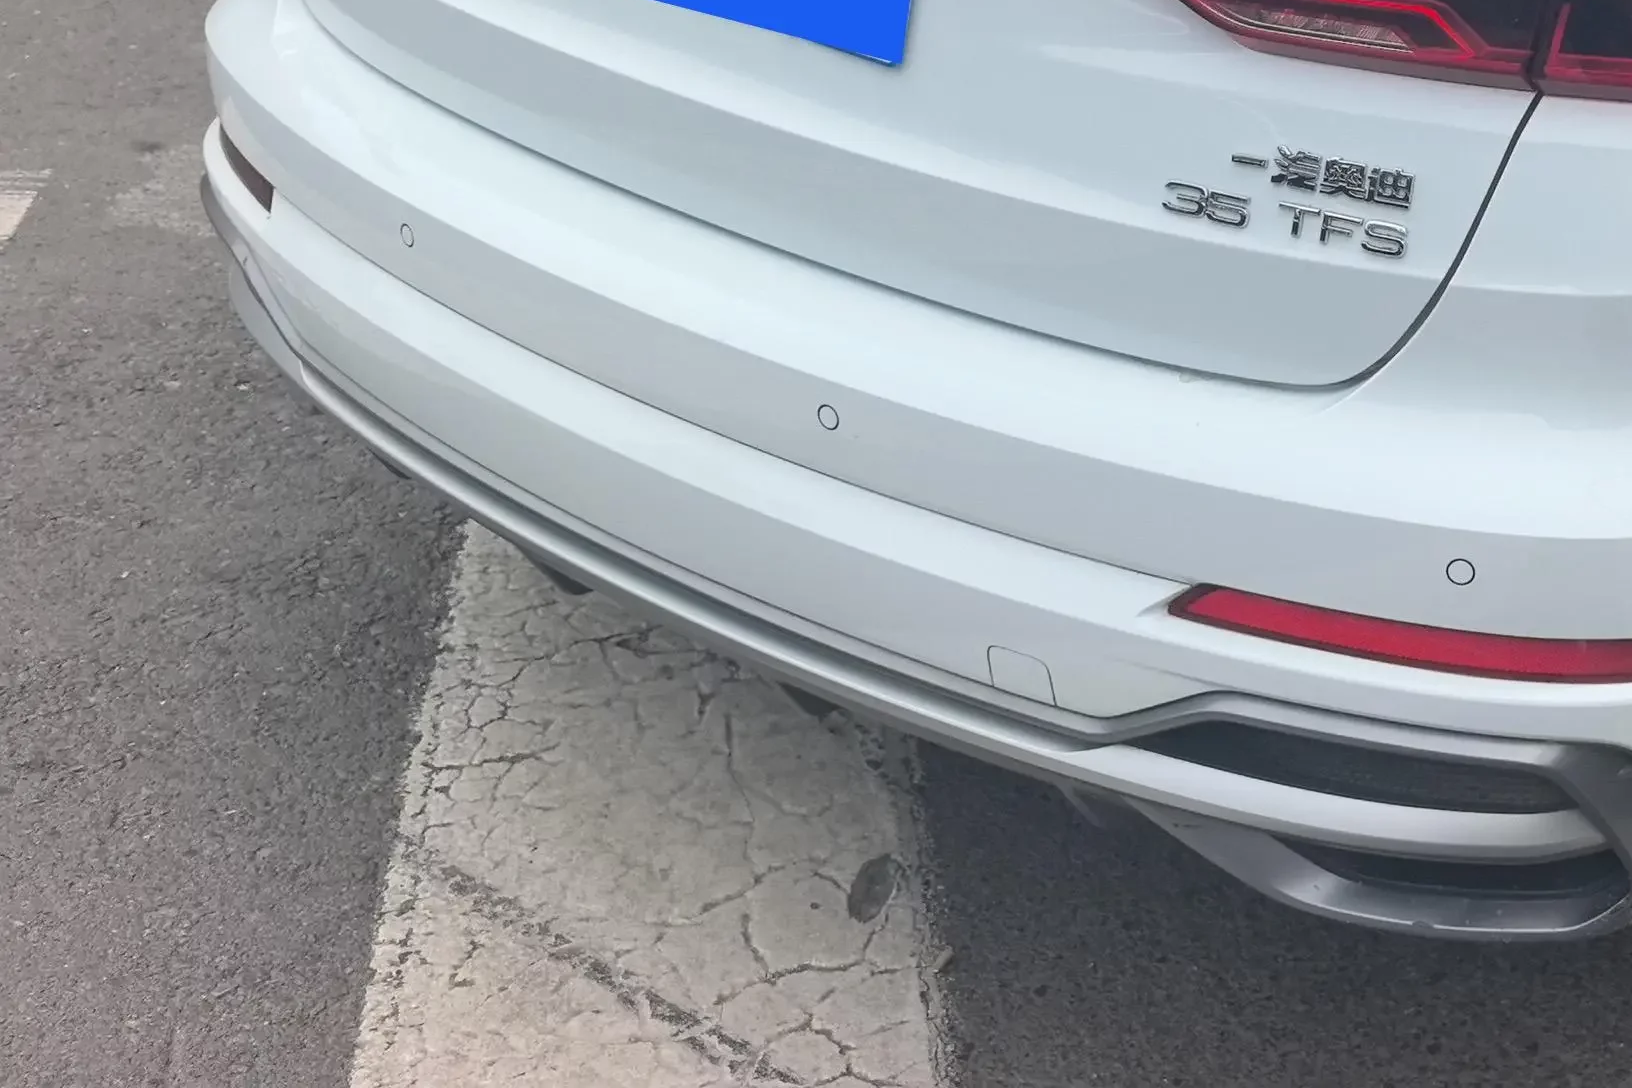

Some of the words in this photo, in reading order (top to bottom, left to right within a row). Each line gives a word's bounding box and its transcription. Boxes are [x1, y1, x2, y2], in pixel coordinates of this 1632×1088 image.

[1230, 143, 1416, 210] 一汽奥迪
[1161, 179, 1250, 229] 35
[1278, 200, 1409, 260] TFS
